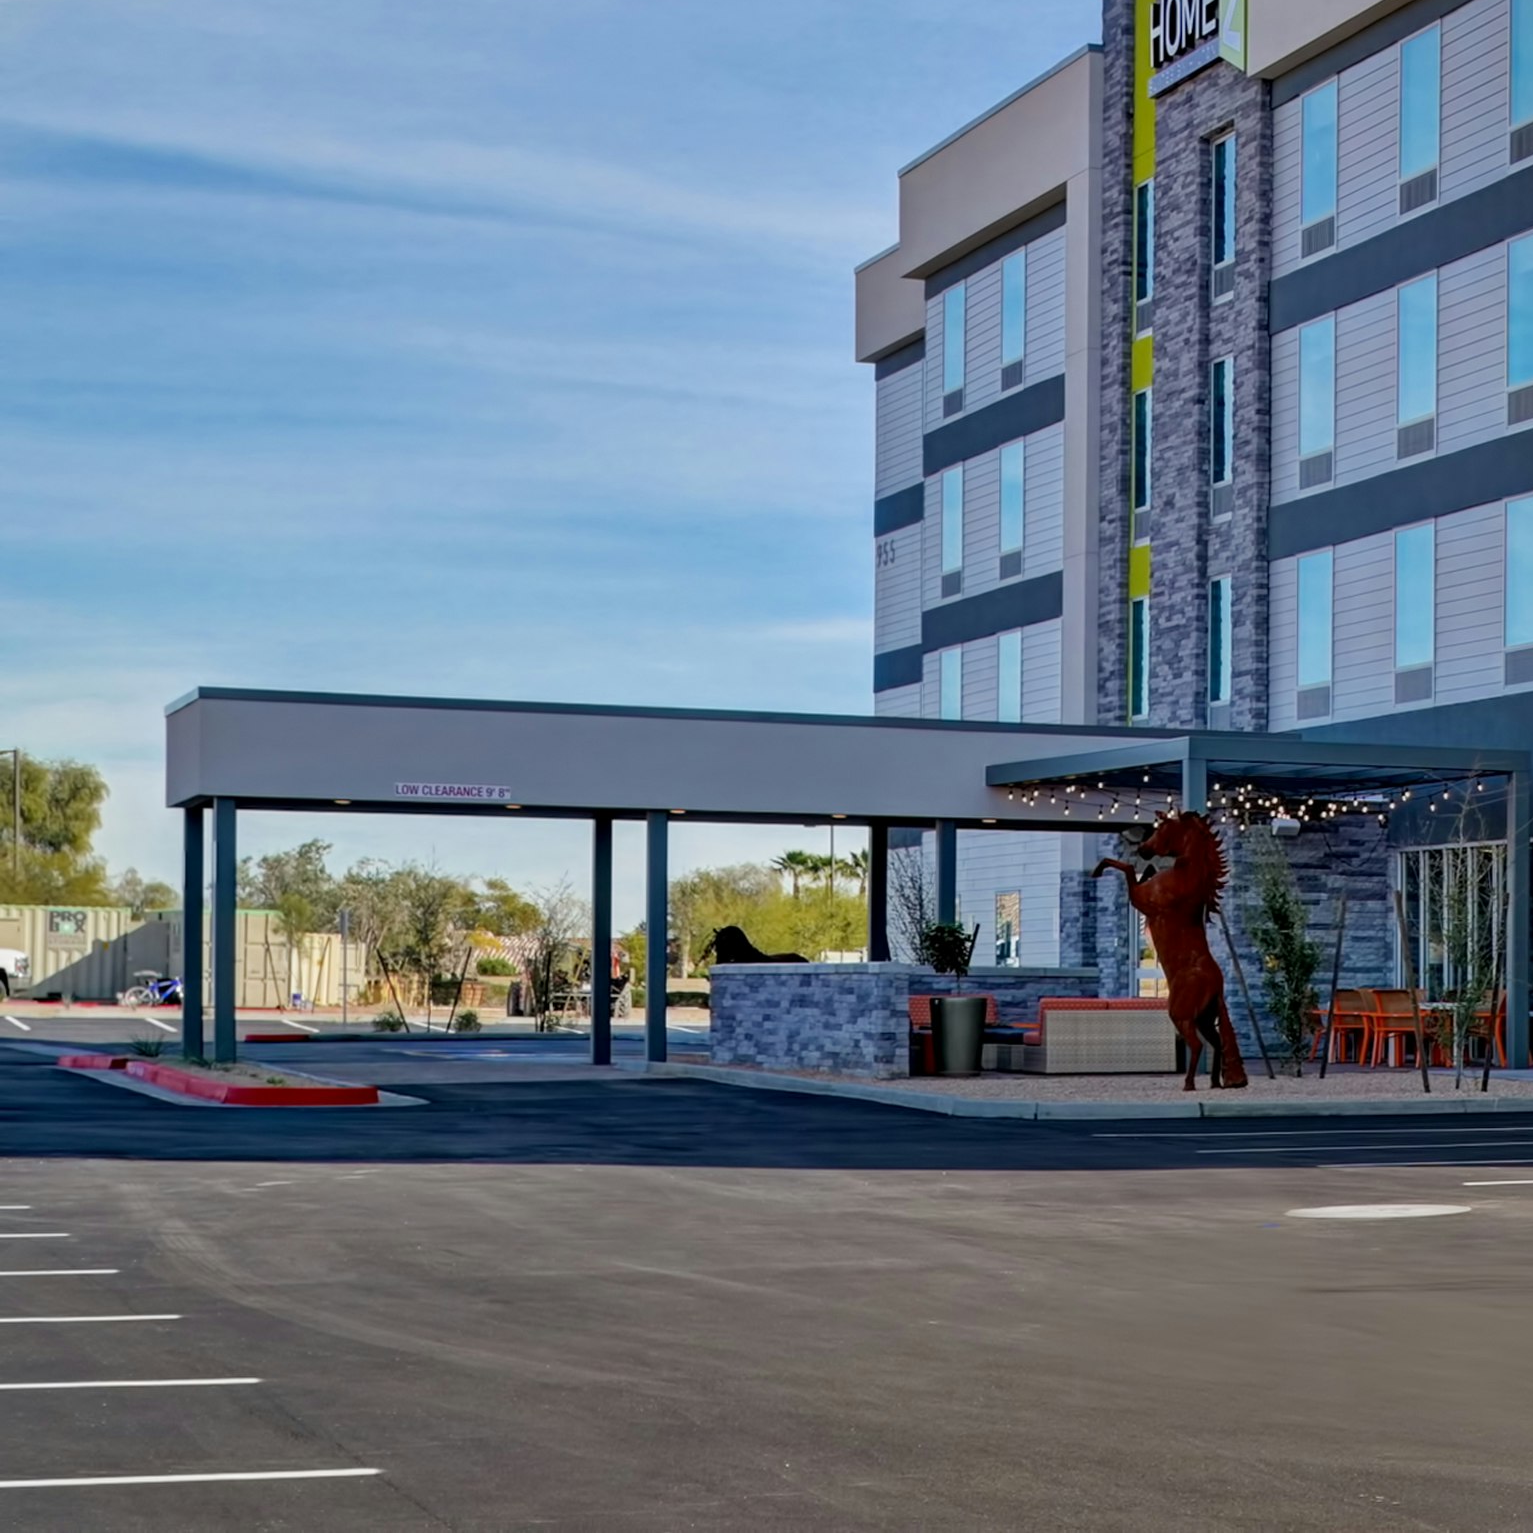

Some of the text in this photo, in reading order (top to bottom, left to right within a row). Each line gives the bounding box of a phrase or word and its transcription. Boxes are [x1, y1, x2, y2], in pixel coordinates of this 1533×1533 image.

[395, 784, 419, 795] LOW
[421, 784, 483, 797] CLEARANCE
[49, 911, 87, 922] PRO
